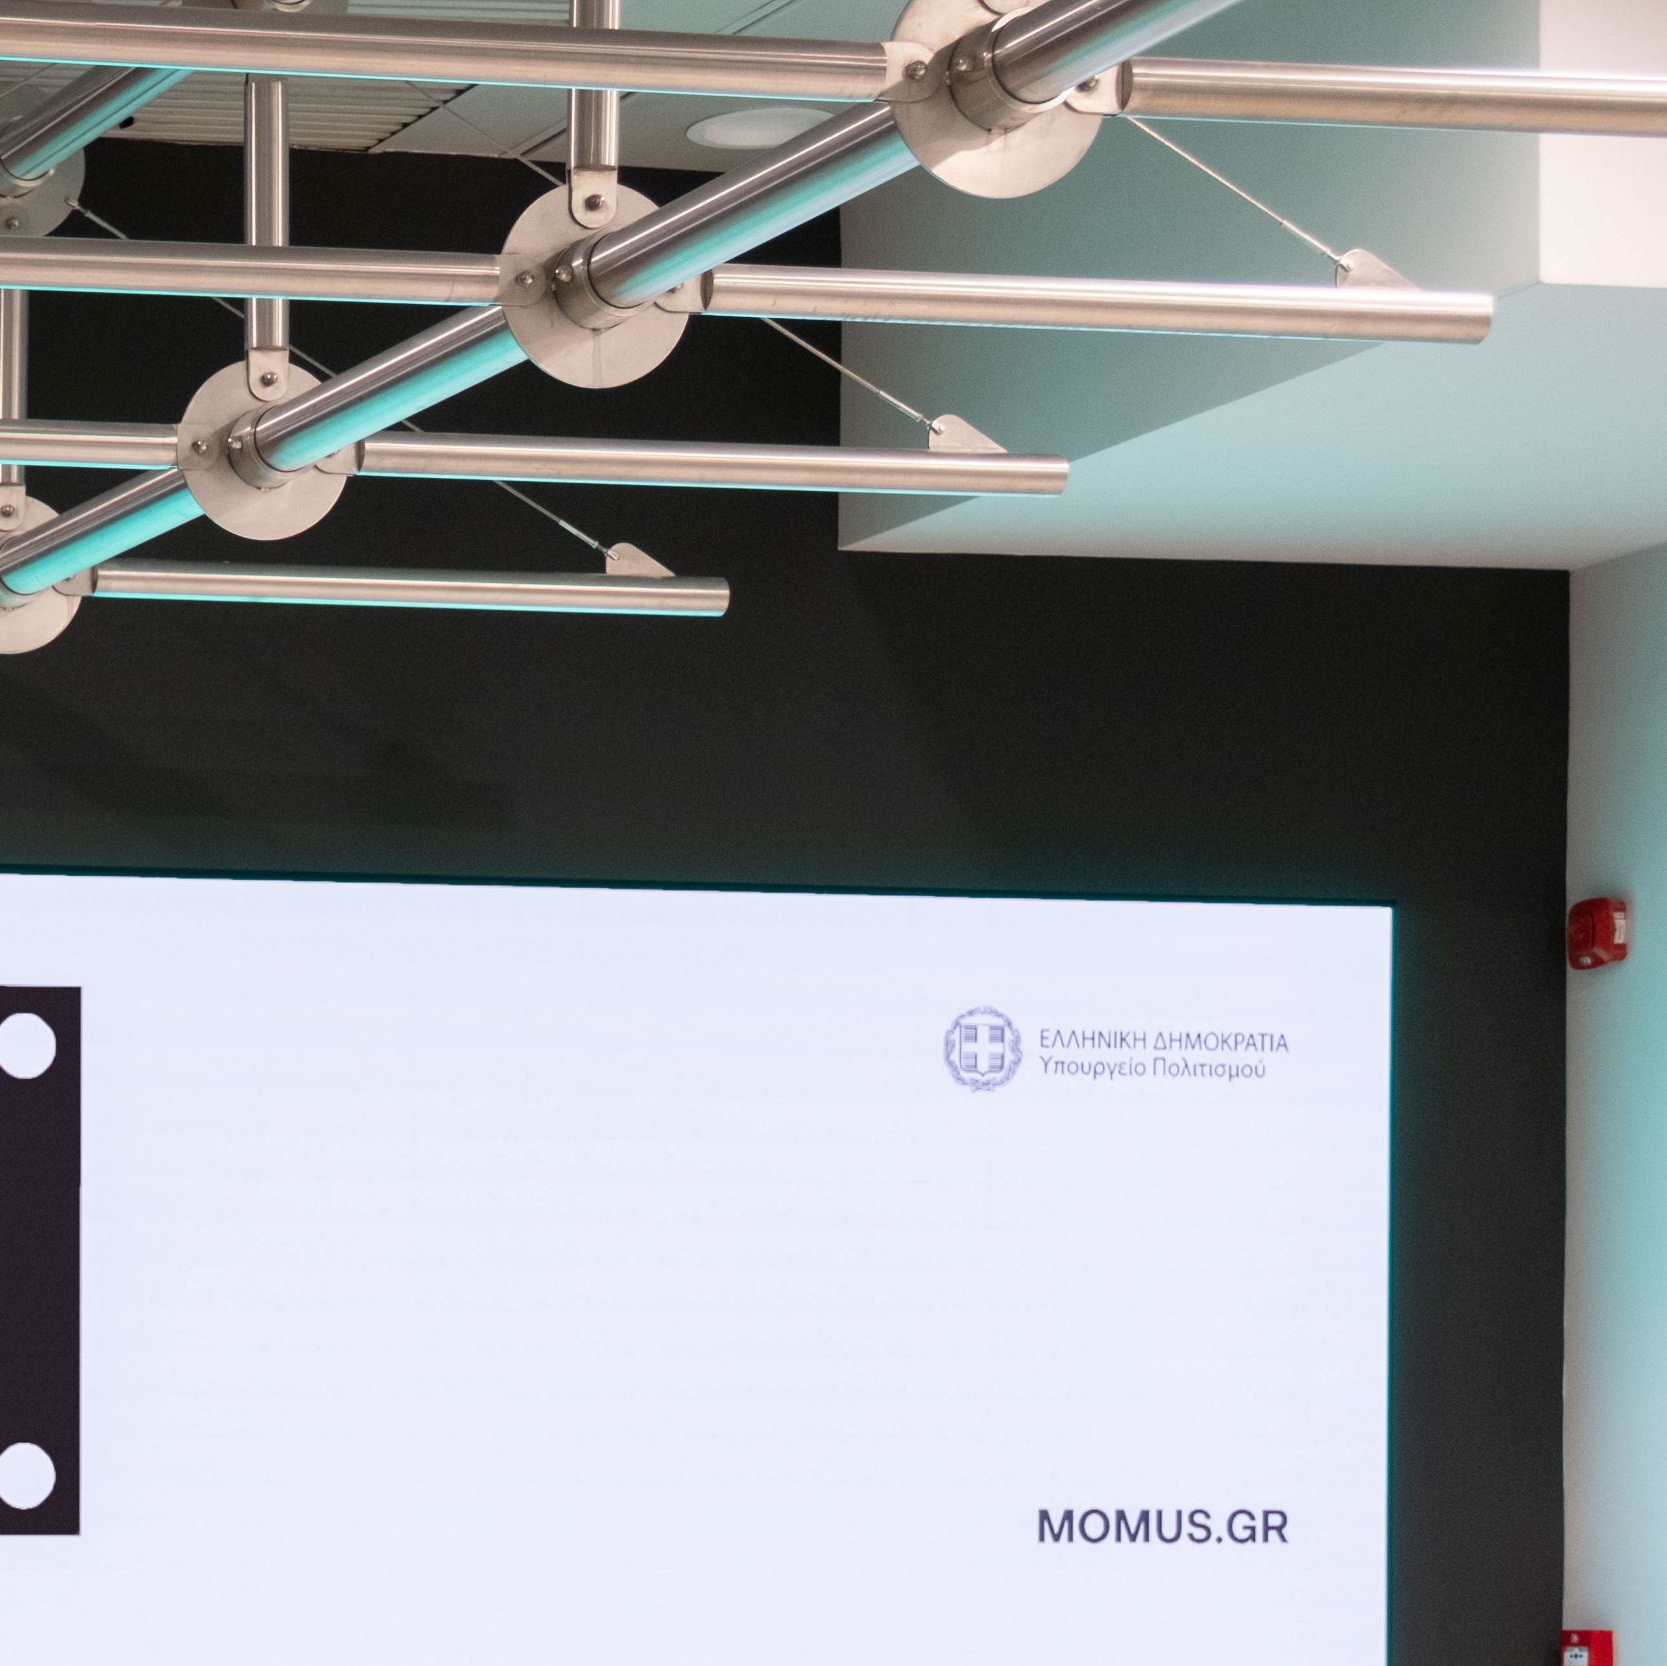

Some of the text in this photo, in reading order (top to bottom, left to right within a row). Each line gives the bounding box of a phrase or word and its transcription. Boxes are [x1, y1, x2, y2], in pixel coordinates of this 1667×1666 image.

[1039, 1027, 1289, 1053] ΕΛΛΗΝΙΚΗ ΔΗΜΟΚΡΑΤΙΑ
[1039, 1055, 1267, 1083] Υπουργείο Πολιτισμού
[1038, 1508, 1289, 1544] MOMUS.GR
